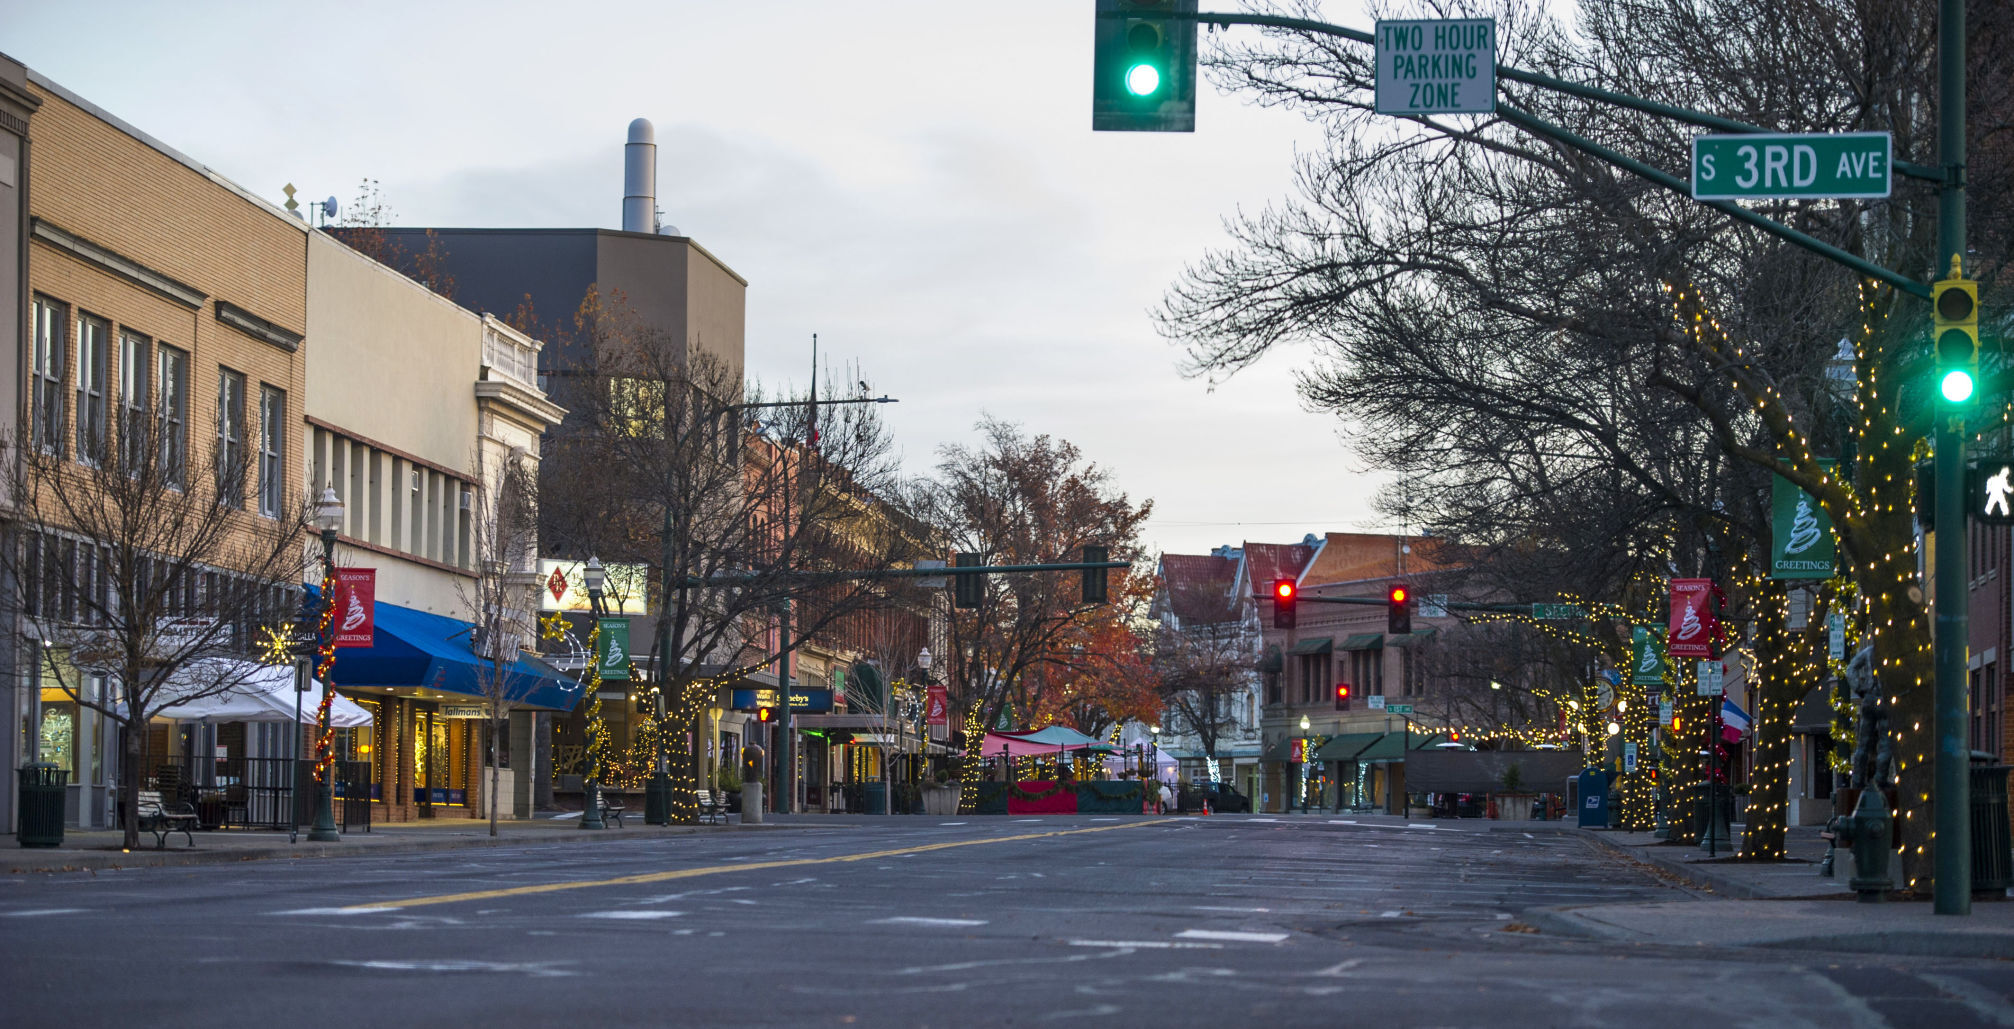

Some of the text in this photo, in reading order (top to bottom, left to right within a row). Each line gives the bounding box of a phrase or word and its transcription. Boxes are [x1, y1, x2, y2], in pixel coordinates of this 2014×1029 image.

[1382, 24, 1489, 52] TWO HOUR
[1393, 53, 1477, 80] PARKING
[1408, 82, 1462, 109] ZONE
[1701, 144, 1883, 189] S 3RD AVE
[1775, 559, 1830, 570] GREETINGS
[1676, 583, 1706, 593] SEASON'S
[1670, 643, 1708, 652] GREETINGS
[776, 694, 809, 703] Seby's
[444, 705, 480, 717] Tallmans
